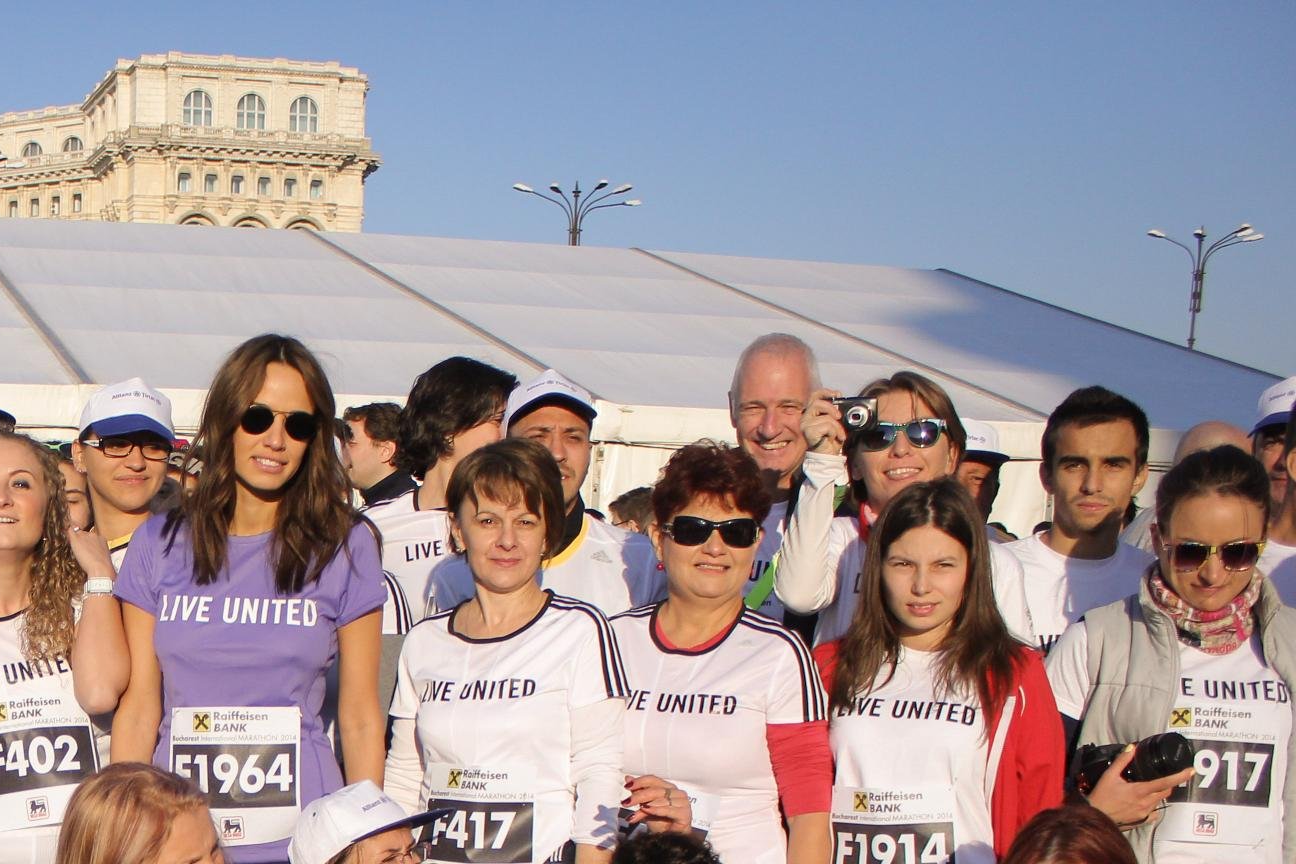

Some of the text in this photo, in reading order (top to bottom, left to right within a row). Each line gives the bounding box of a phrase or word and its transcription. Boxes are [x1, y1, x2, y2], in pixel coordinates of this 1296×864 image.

[405, 540, 443, 562] LIVE
[159, 595, 318, 627] LIVE UNITED
[459, 678, 536, 700] UNITED
[1204, 680, 1288, 704] UNITED
[9, 697, 61, 710] Raiffeisen
[657, 693, 737, 715] UNITED
[11, 708, 43, 720] BANK
[213, 711, 269, 721] Raiffeisen
[836, 697, 976, 726] LIVE UNITED
[1195, 707, 1252, 719] Raiffeisen
[213, 723, 248, 733] BANK
[1195, 719, 1229, 729] BANK
[175, 753, 293, 794] F1964
[462, 769, 509, 780] Raiffeisen
[1180, 749, 1270, 792] 917
[460, 780, 488, 790] BANK
[868, 791, 924, 802] Raiffeisen
[869, 803, 902, 813] BANK
[836, 832, 950, 864] F1914
